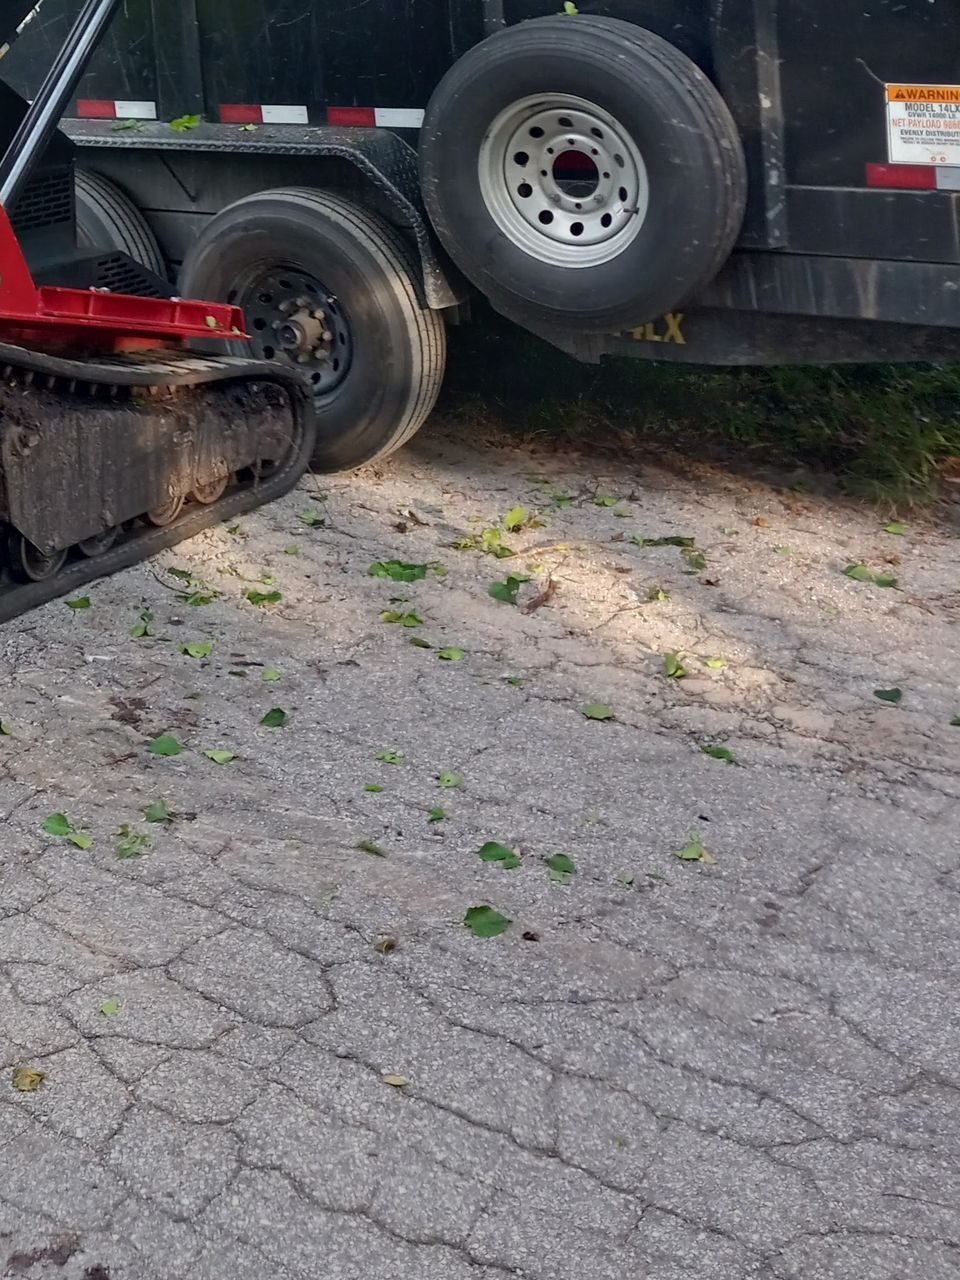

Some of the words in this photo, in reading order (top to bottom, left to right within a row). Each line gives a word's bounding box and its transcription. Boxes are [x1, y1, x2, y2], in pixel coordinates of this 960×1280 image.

[906, 89, 960, 100] WARNIN
[905, 103, 936, 112] MODEL
[892, 119, 906, 127] NET
[908, 119, 941, 129] PAYLOAD
[925, 130, 960, 138] DISTRIBUT
